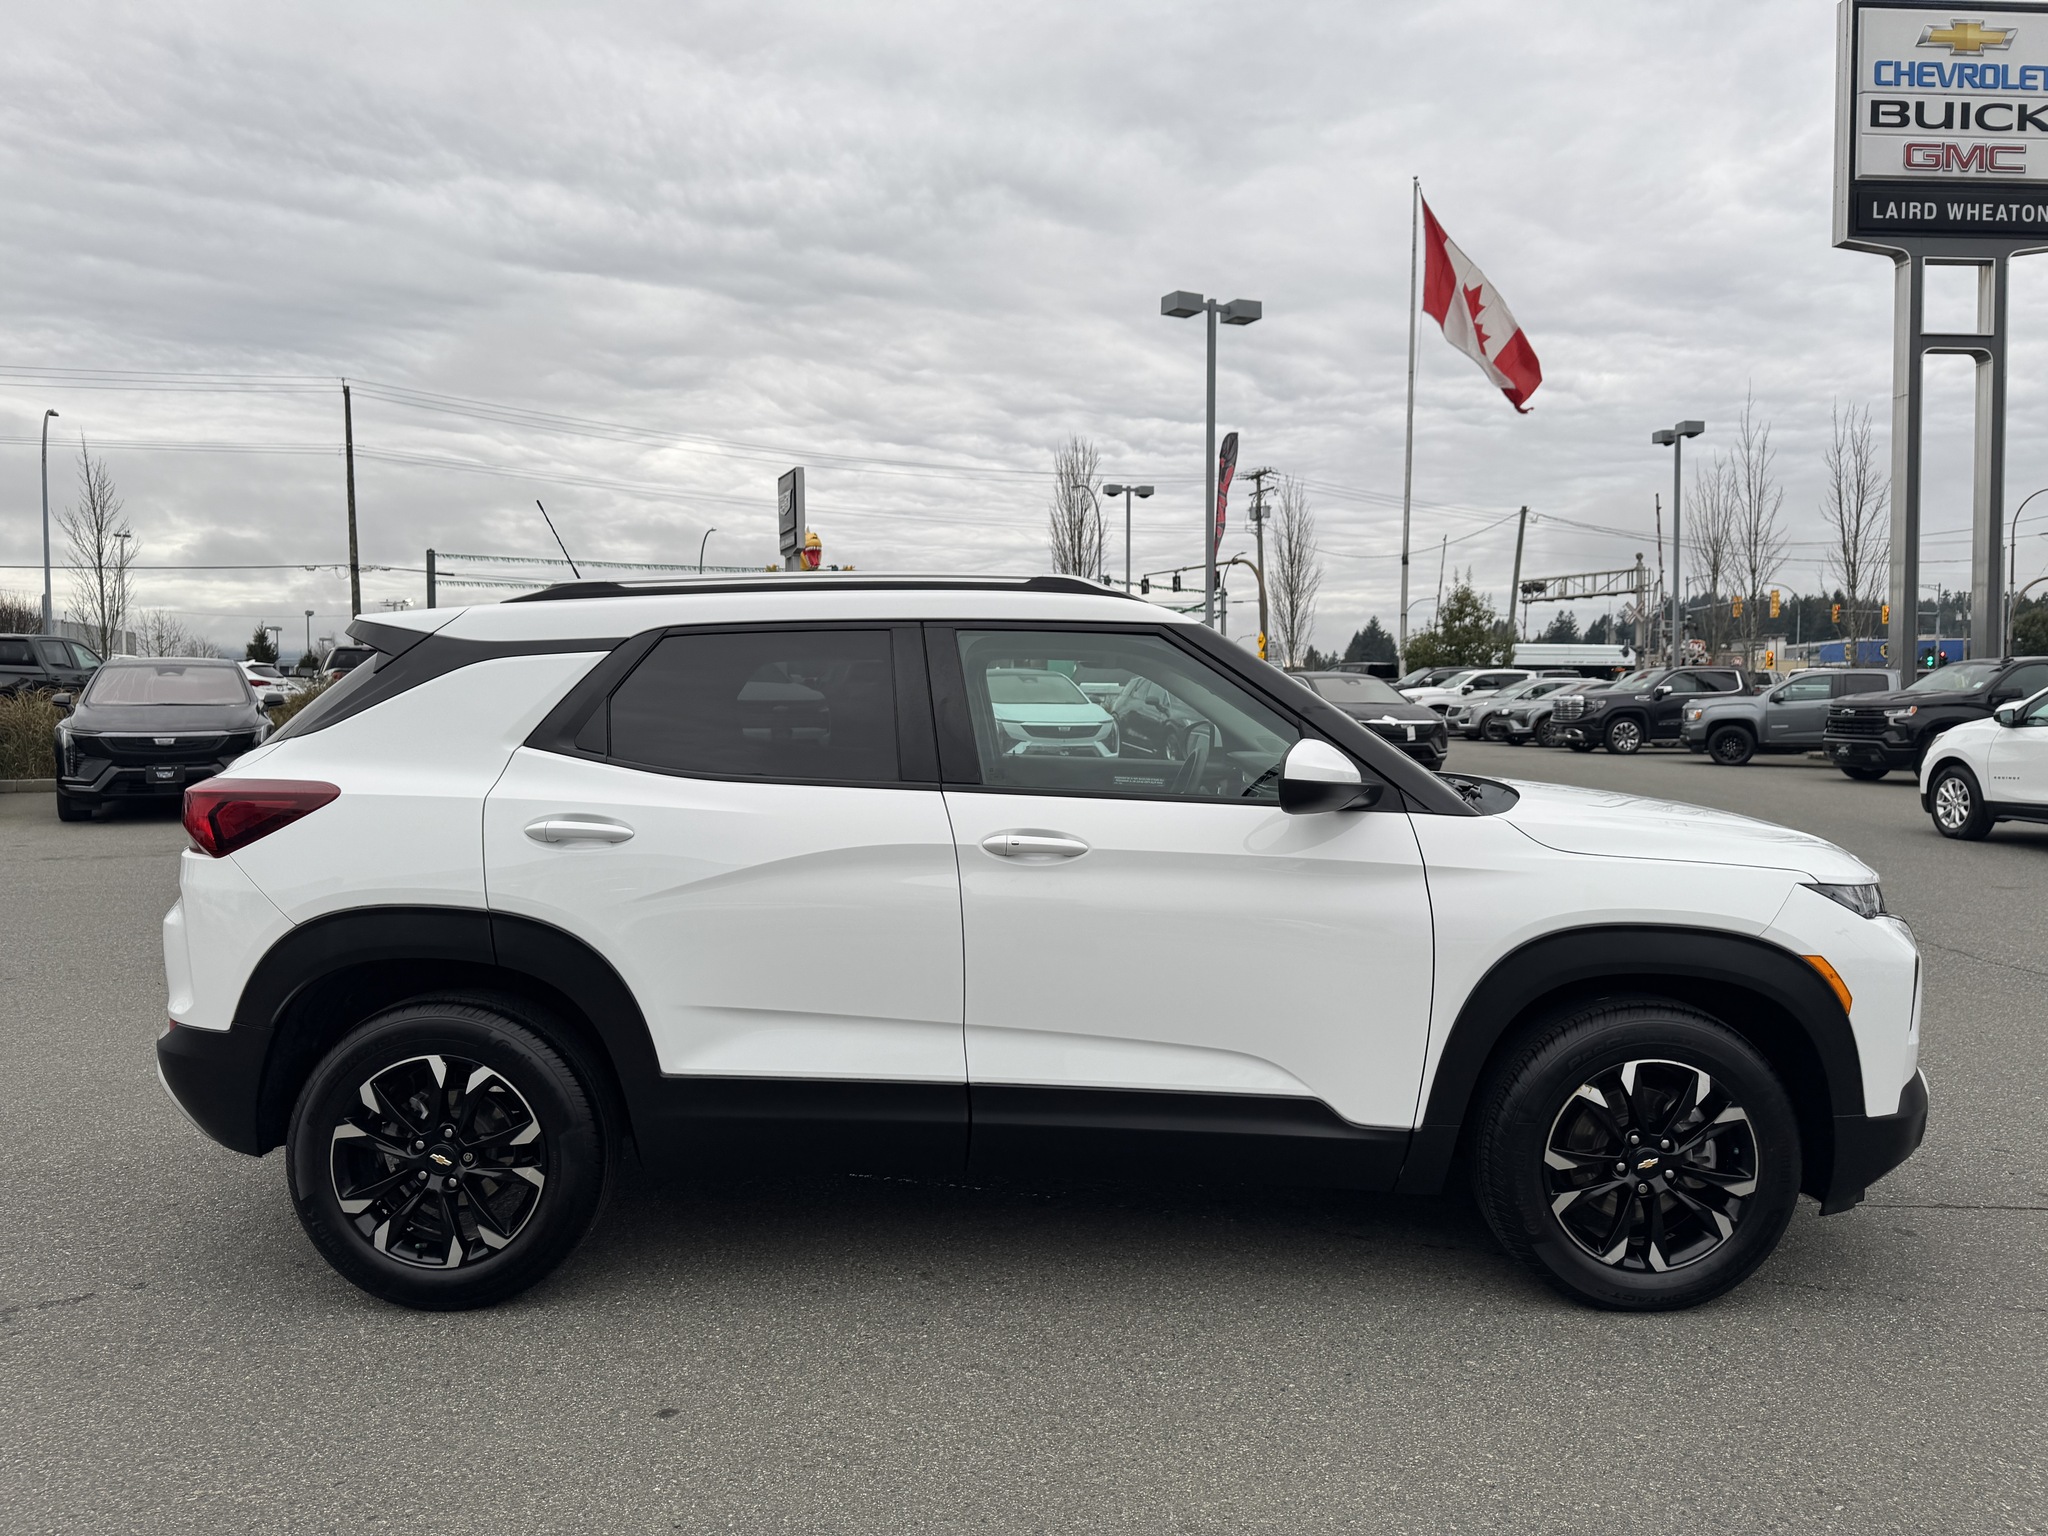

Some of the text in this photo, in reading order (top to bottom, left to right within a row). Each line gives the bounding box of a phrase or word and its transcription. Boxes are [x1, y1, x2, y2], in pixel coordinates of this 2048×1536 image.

[1870, 100, 2048, 132] BUICK
[1904, 141, 2026, 174] GMC
[1872, 201, 2048, 223] LAIRD WHEATON
